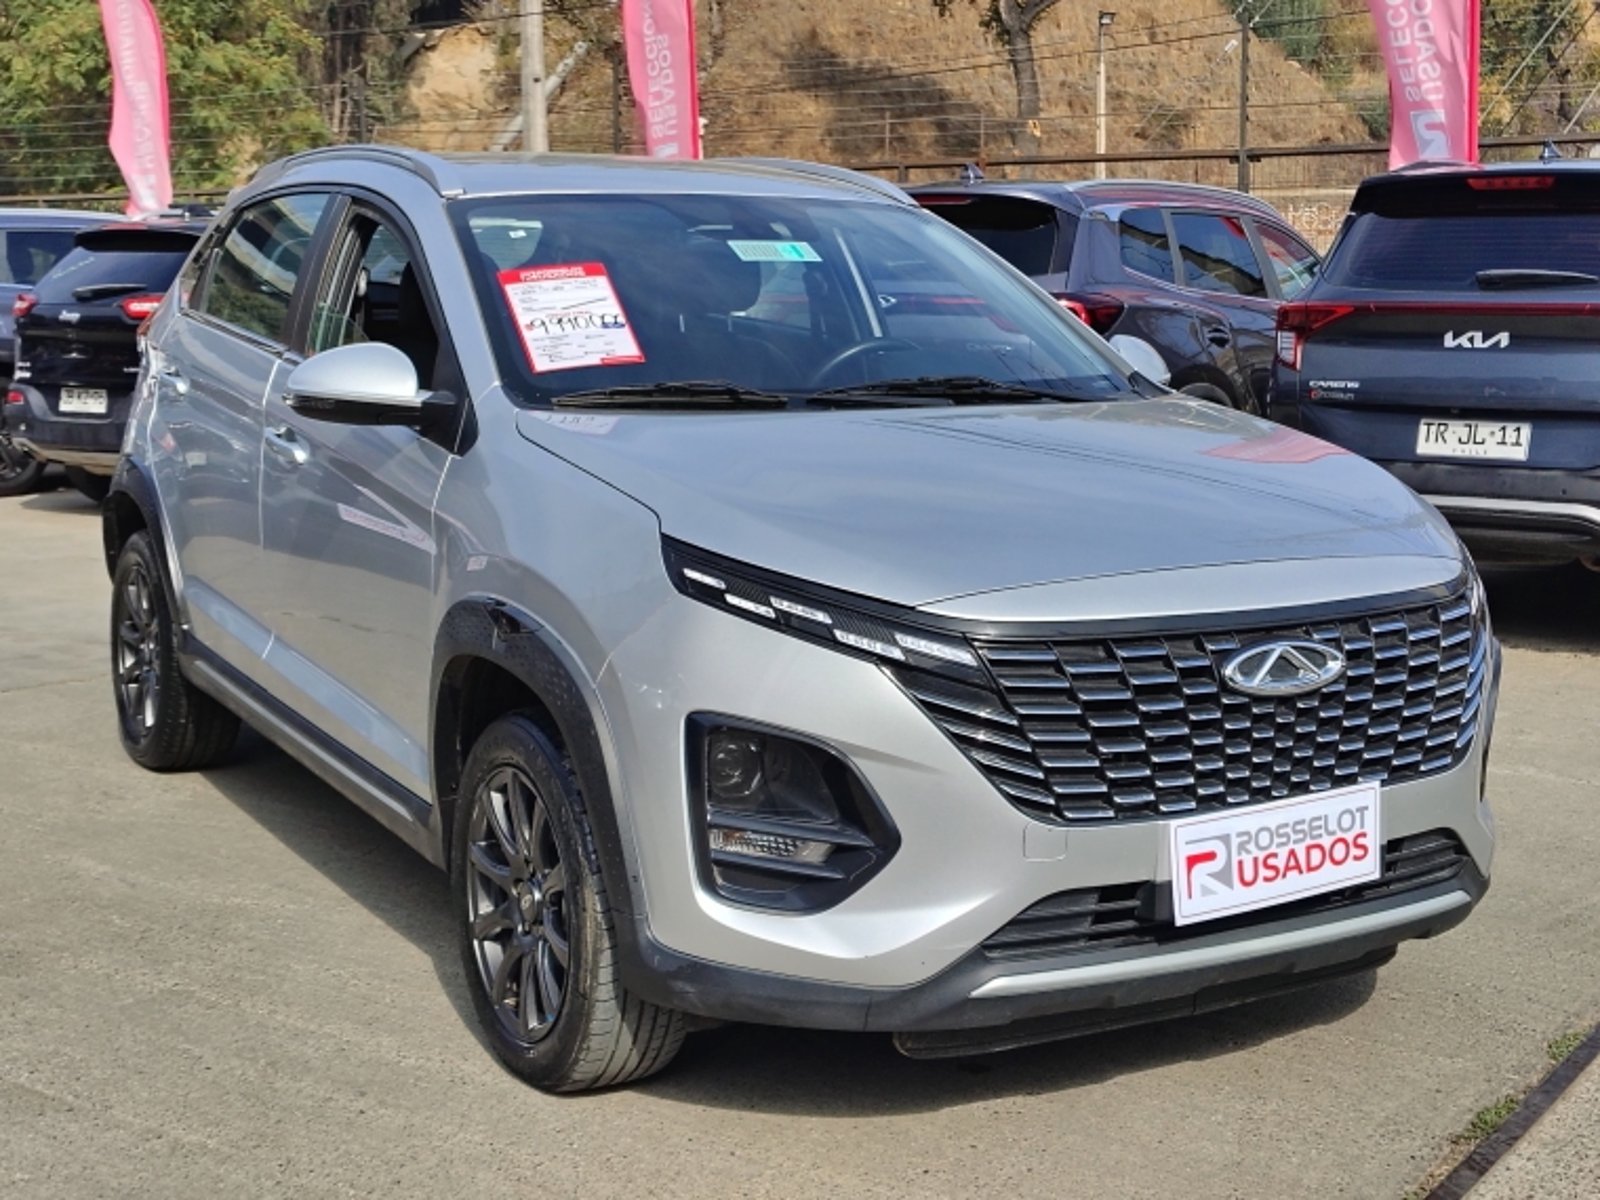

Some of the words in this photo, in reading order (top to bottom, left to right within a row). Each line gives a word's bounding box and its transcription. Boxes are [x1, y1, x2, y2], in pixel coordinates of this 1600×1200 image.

[1443, 330, 1511, 349] KIA
[1236, 806, 1369, 856] ROSSELOT
[1237, 832, 1369, 888] USADOS
